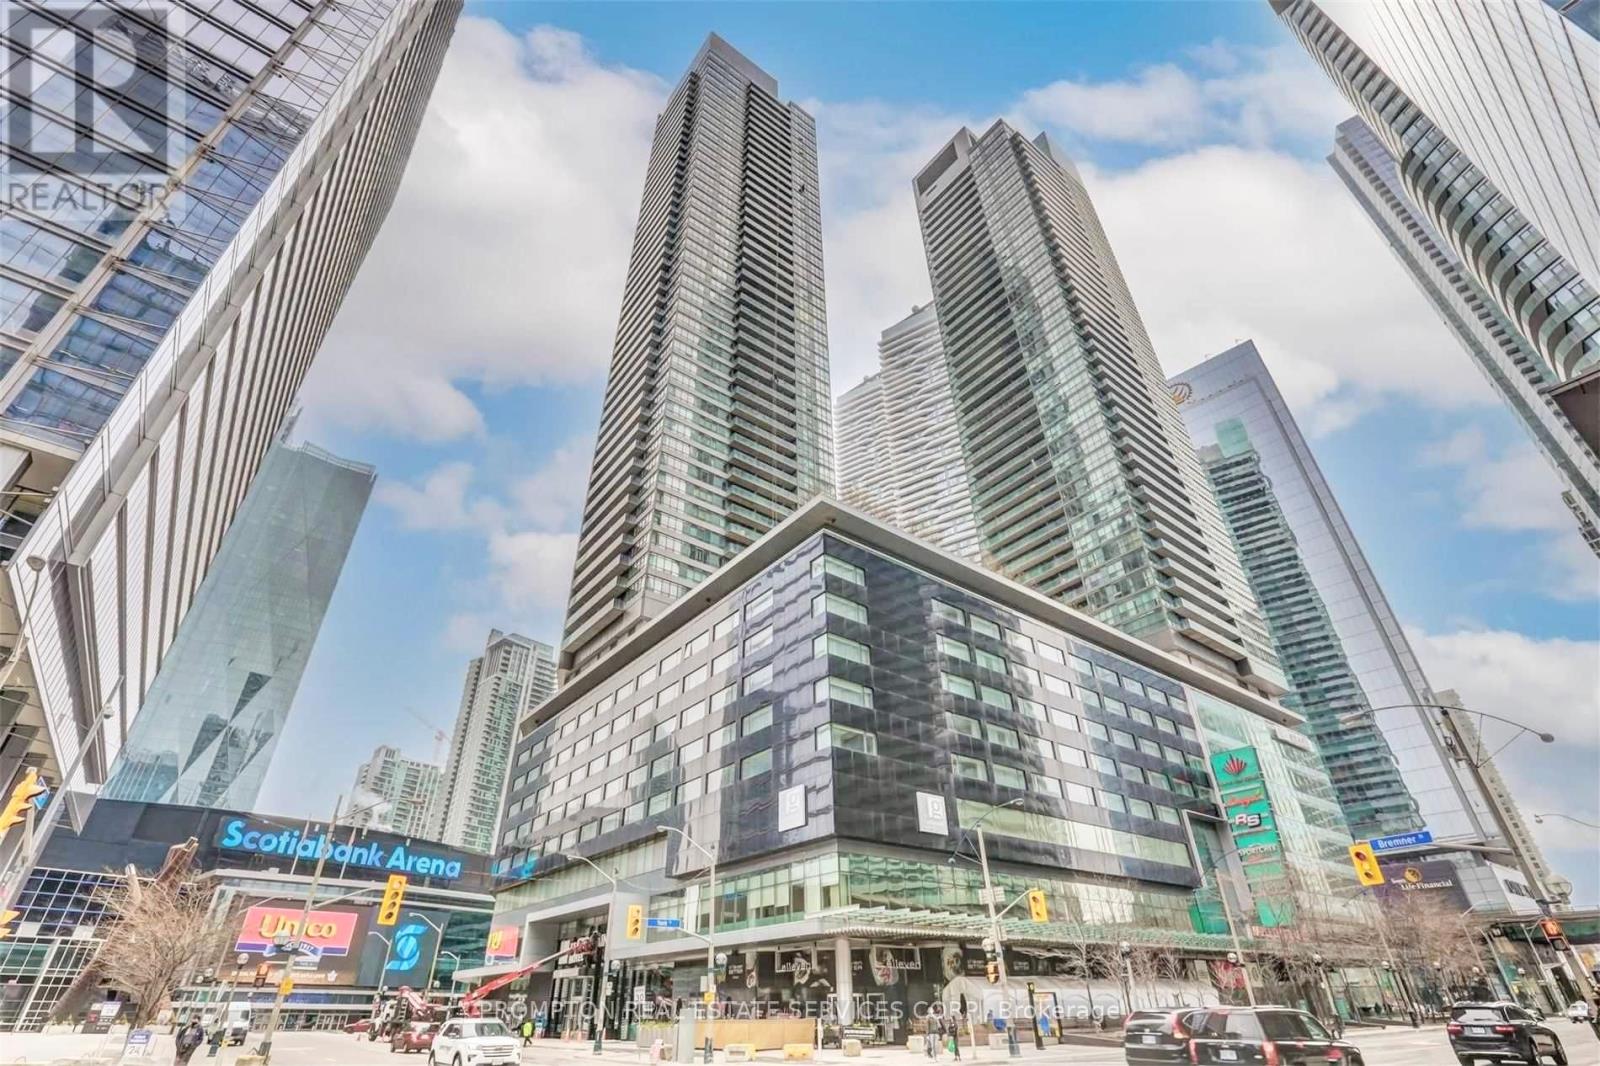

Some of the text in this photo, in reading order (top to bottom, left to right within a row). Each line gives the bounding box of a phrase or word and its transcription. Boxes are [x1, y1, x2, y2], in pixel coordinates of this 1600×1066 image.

[1378, 836, 1417, 849] Bremner
[222, 820, 462, 879] Scotiabank Arena
[1416, 879, 1454, 889] Financial
